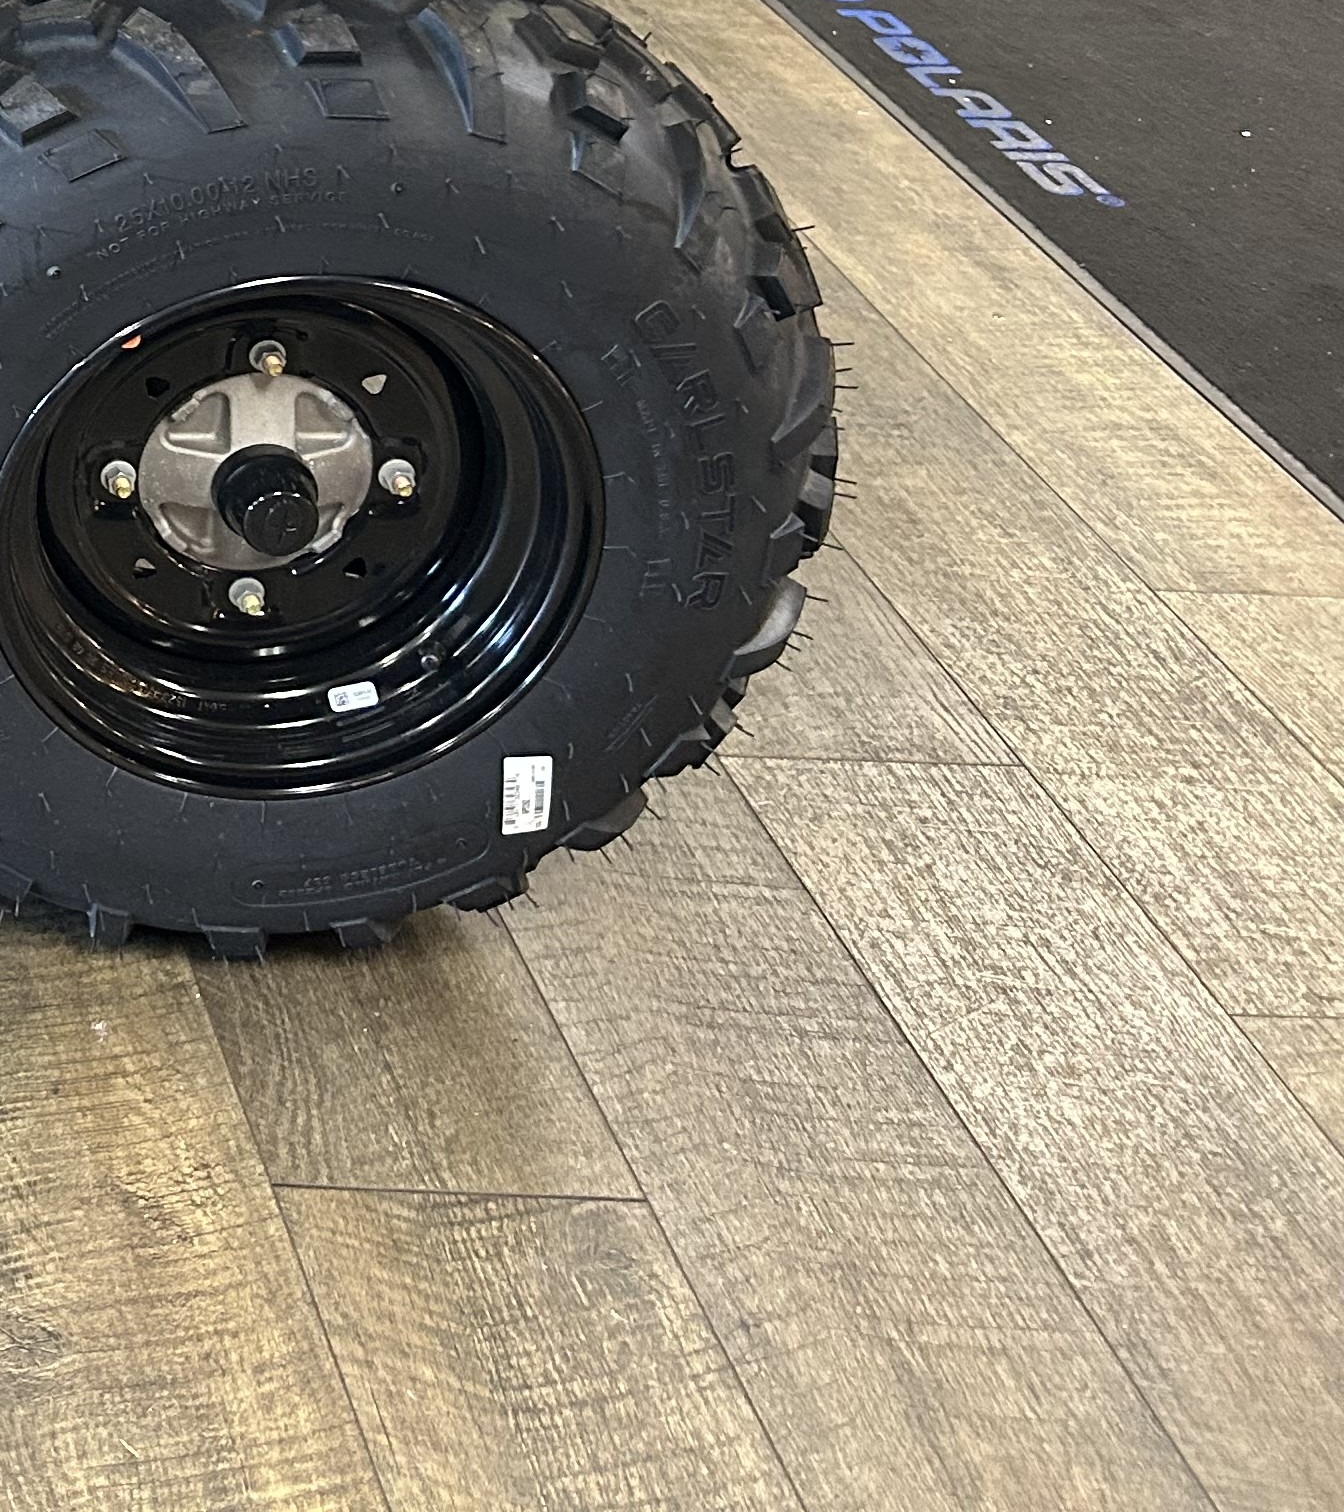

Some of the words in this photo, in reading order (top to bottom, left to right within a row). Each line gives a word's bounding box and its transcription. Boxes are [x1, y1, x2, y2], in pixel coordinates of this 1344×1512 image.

[837, 9, 1109, 197] POLARIS
[264, 167, 316, 188] NHS
[95, 237, 130, 260] NOT
